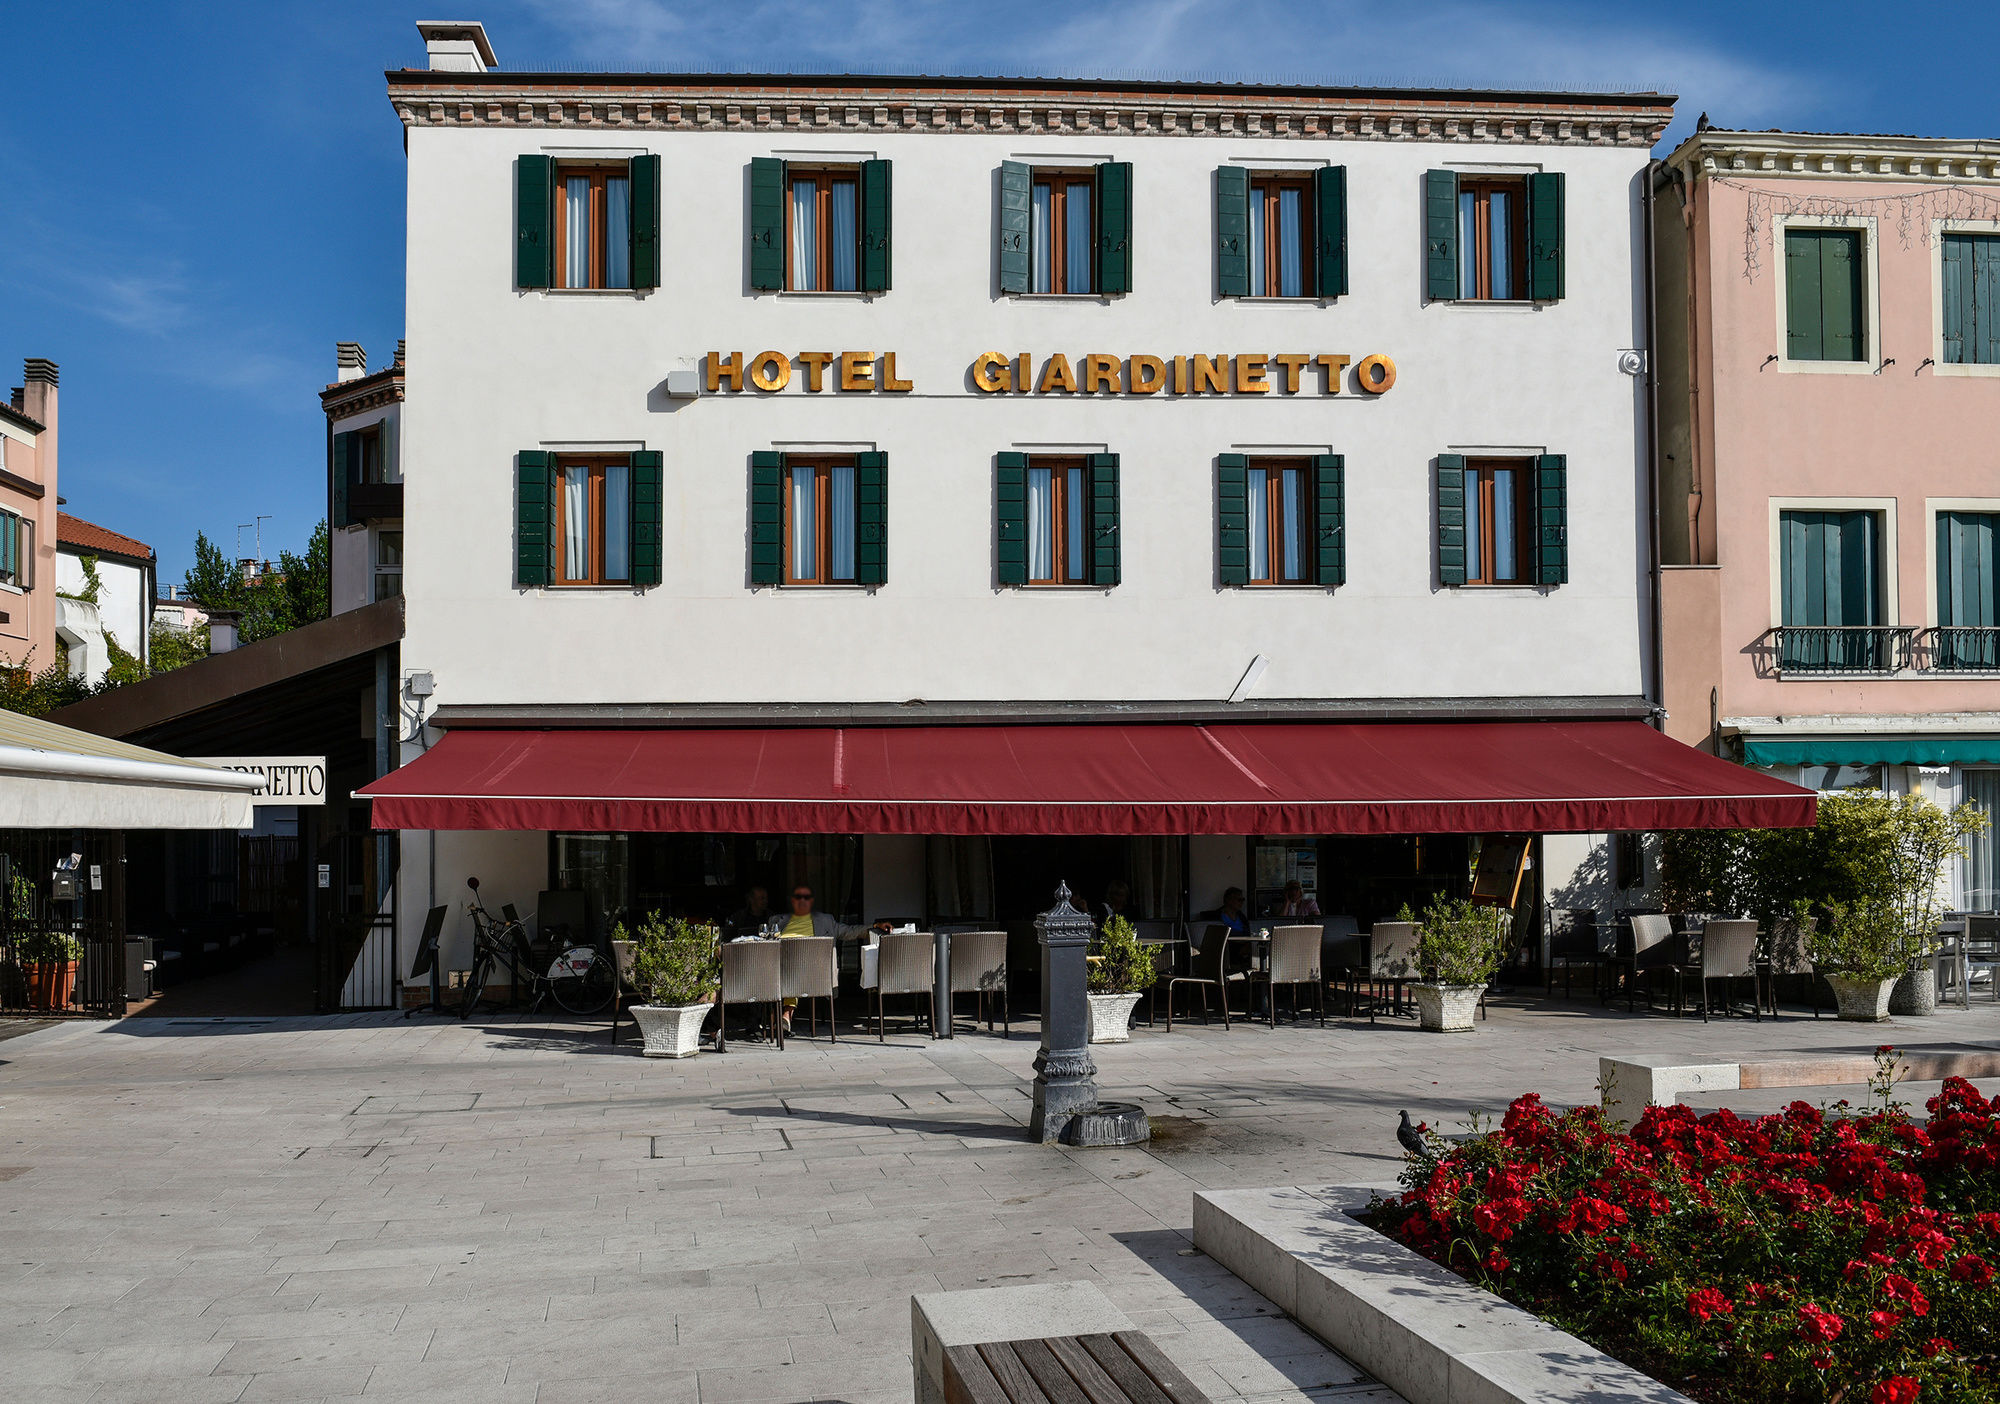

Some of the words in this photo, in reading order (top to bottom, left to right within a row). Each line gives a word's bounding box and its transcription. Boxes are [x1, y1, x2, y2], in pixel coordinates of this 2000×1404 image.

[706, 350, 914, 392] HOTEL
[973, 351, 1398, 395] GIARDINETTO
[221, 764, 325, 797] INETTO
